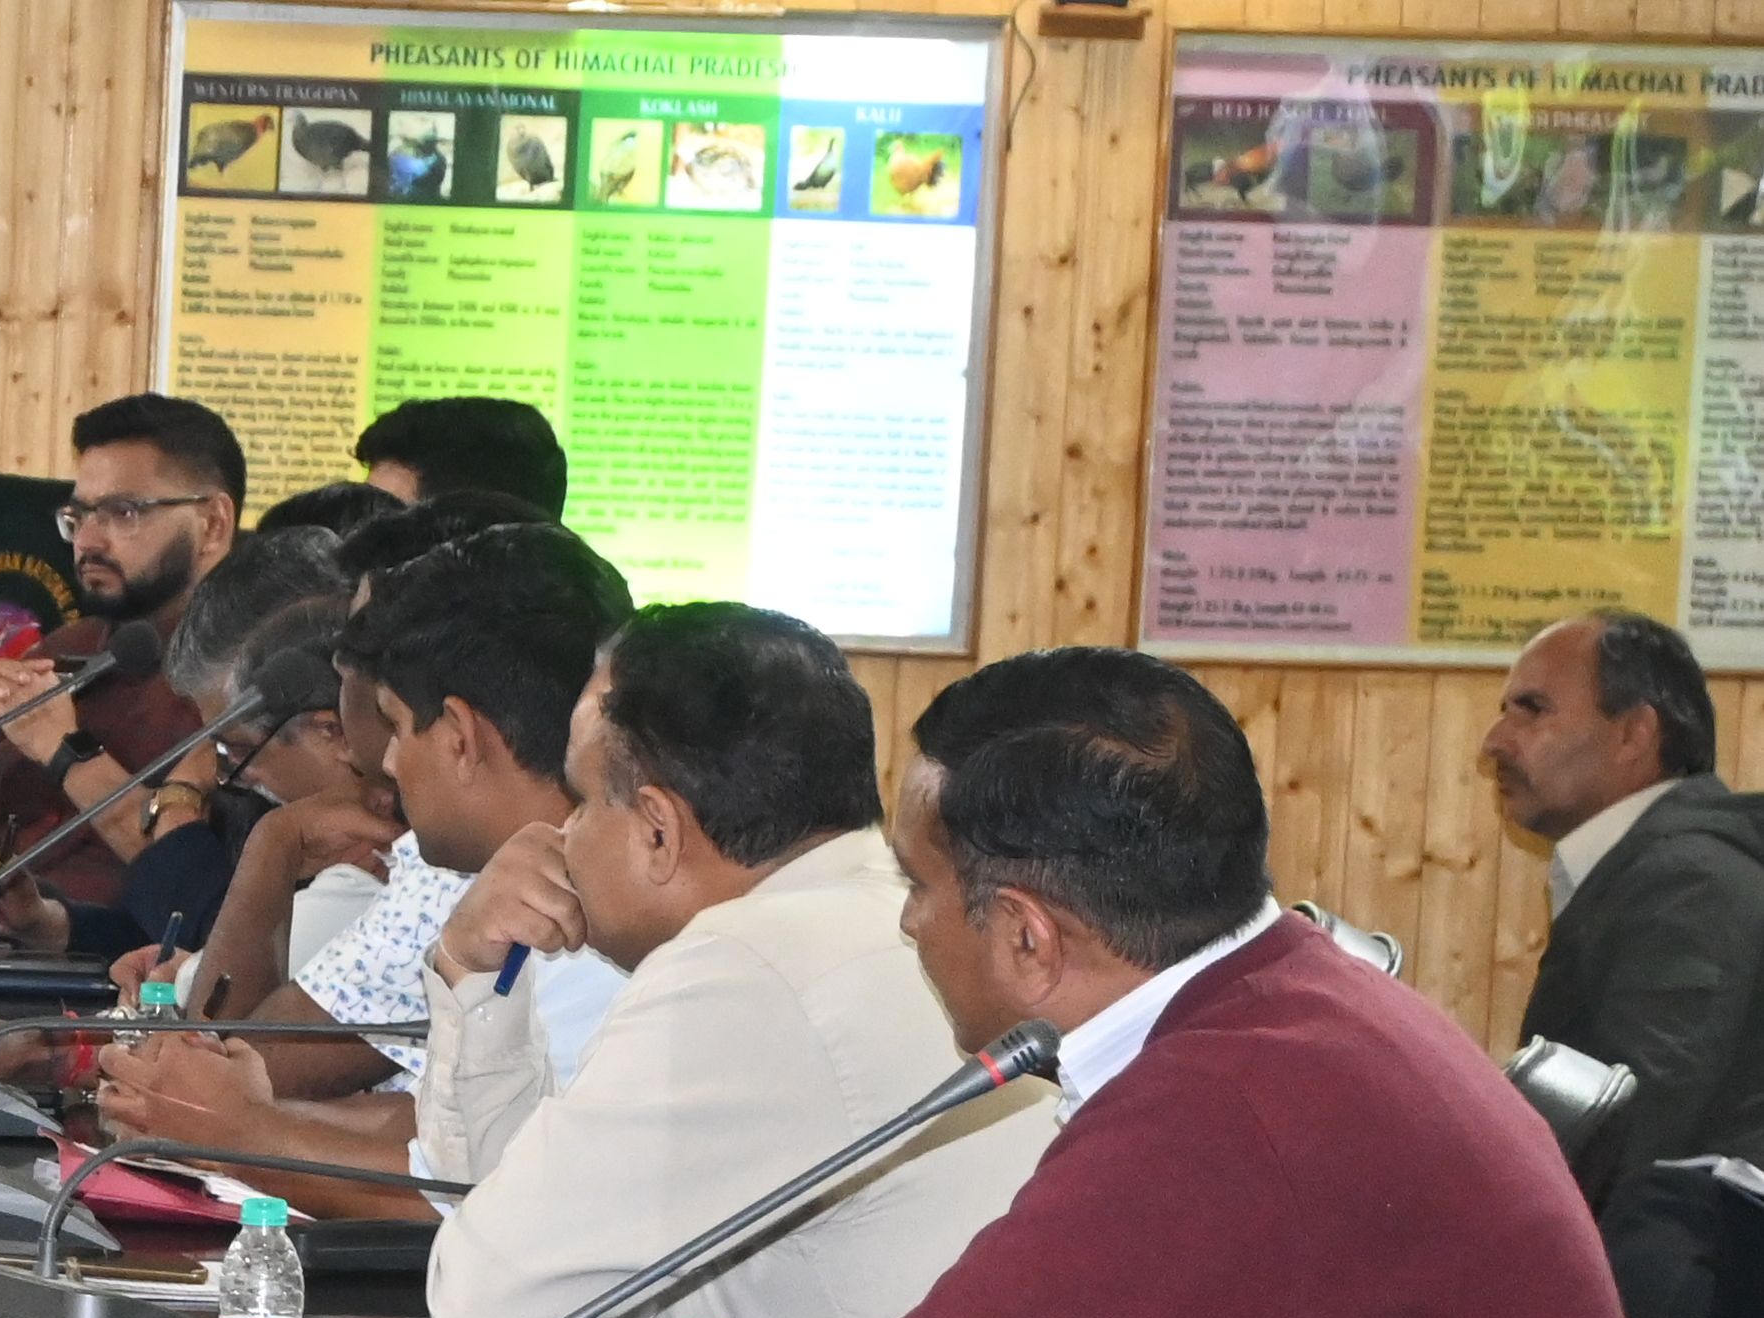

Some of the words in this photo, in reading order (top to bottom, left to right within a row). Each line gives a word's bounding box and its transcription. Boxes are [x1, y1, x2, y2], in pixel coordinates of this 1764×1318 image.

[370, 42, 505, 69] PHEASANTS
[515, 46, 546, 70] OF
[554, 49, 679, 75] HIMACHAL
[1347, 63, 1496, 88] PHEASANTS
[275, 82, 360, 101] TRAGOPAN
